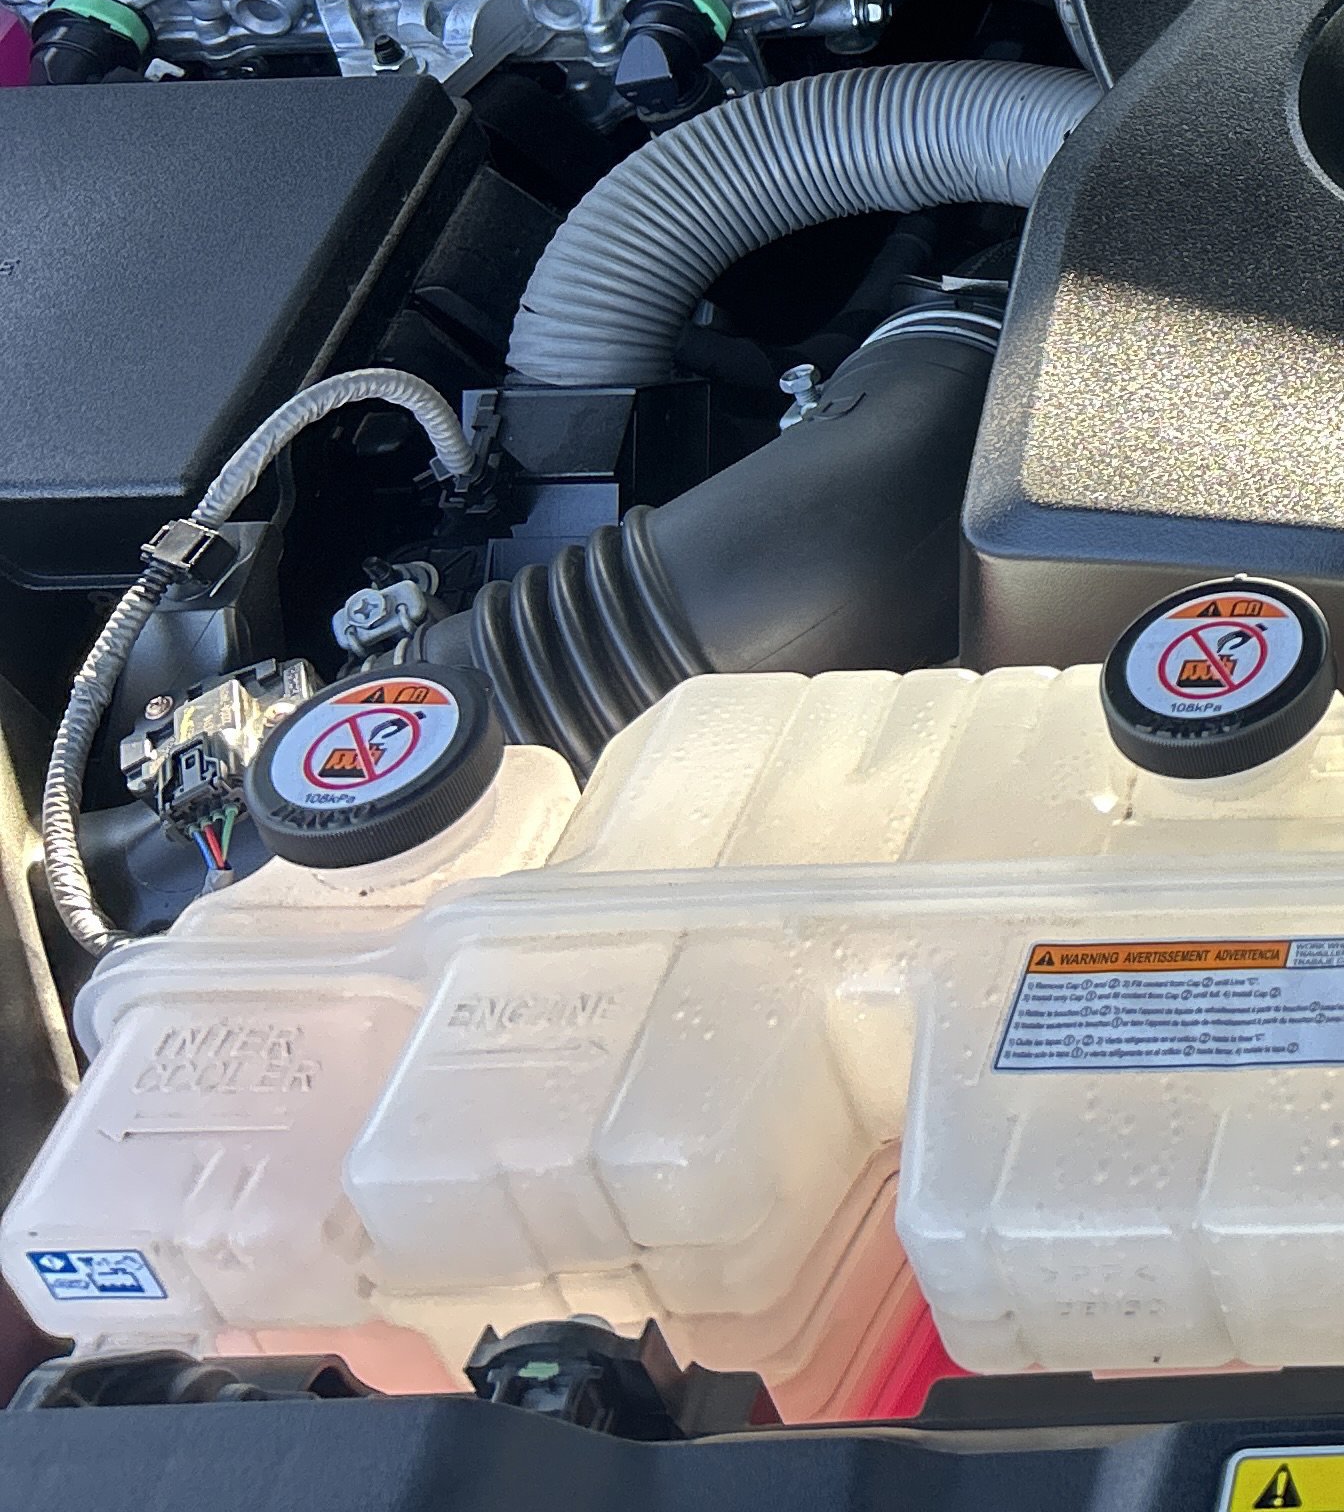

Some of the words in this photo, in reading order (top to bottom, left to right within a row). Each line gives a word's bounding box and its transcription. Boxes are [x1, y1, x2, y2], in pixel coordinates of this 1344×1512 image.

[1059, 951, 1119, 965] WARNING
[1123, 950, 1210, 964] AVERTISSEMENT
[1214, 949, 1281, 963] ADVERTENCIA
[447, 991, 620, 1032] ENGINE
[152, 1020, 307, 1060] INTER
